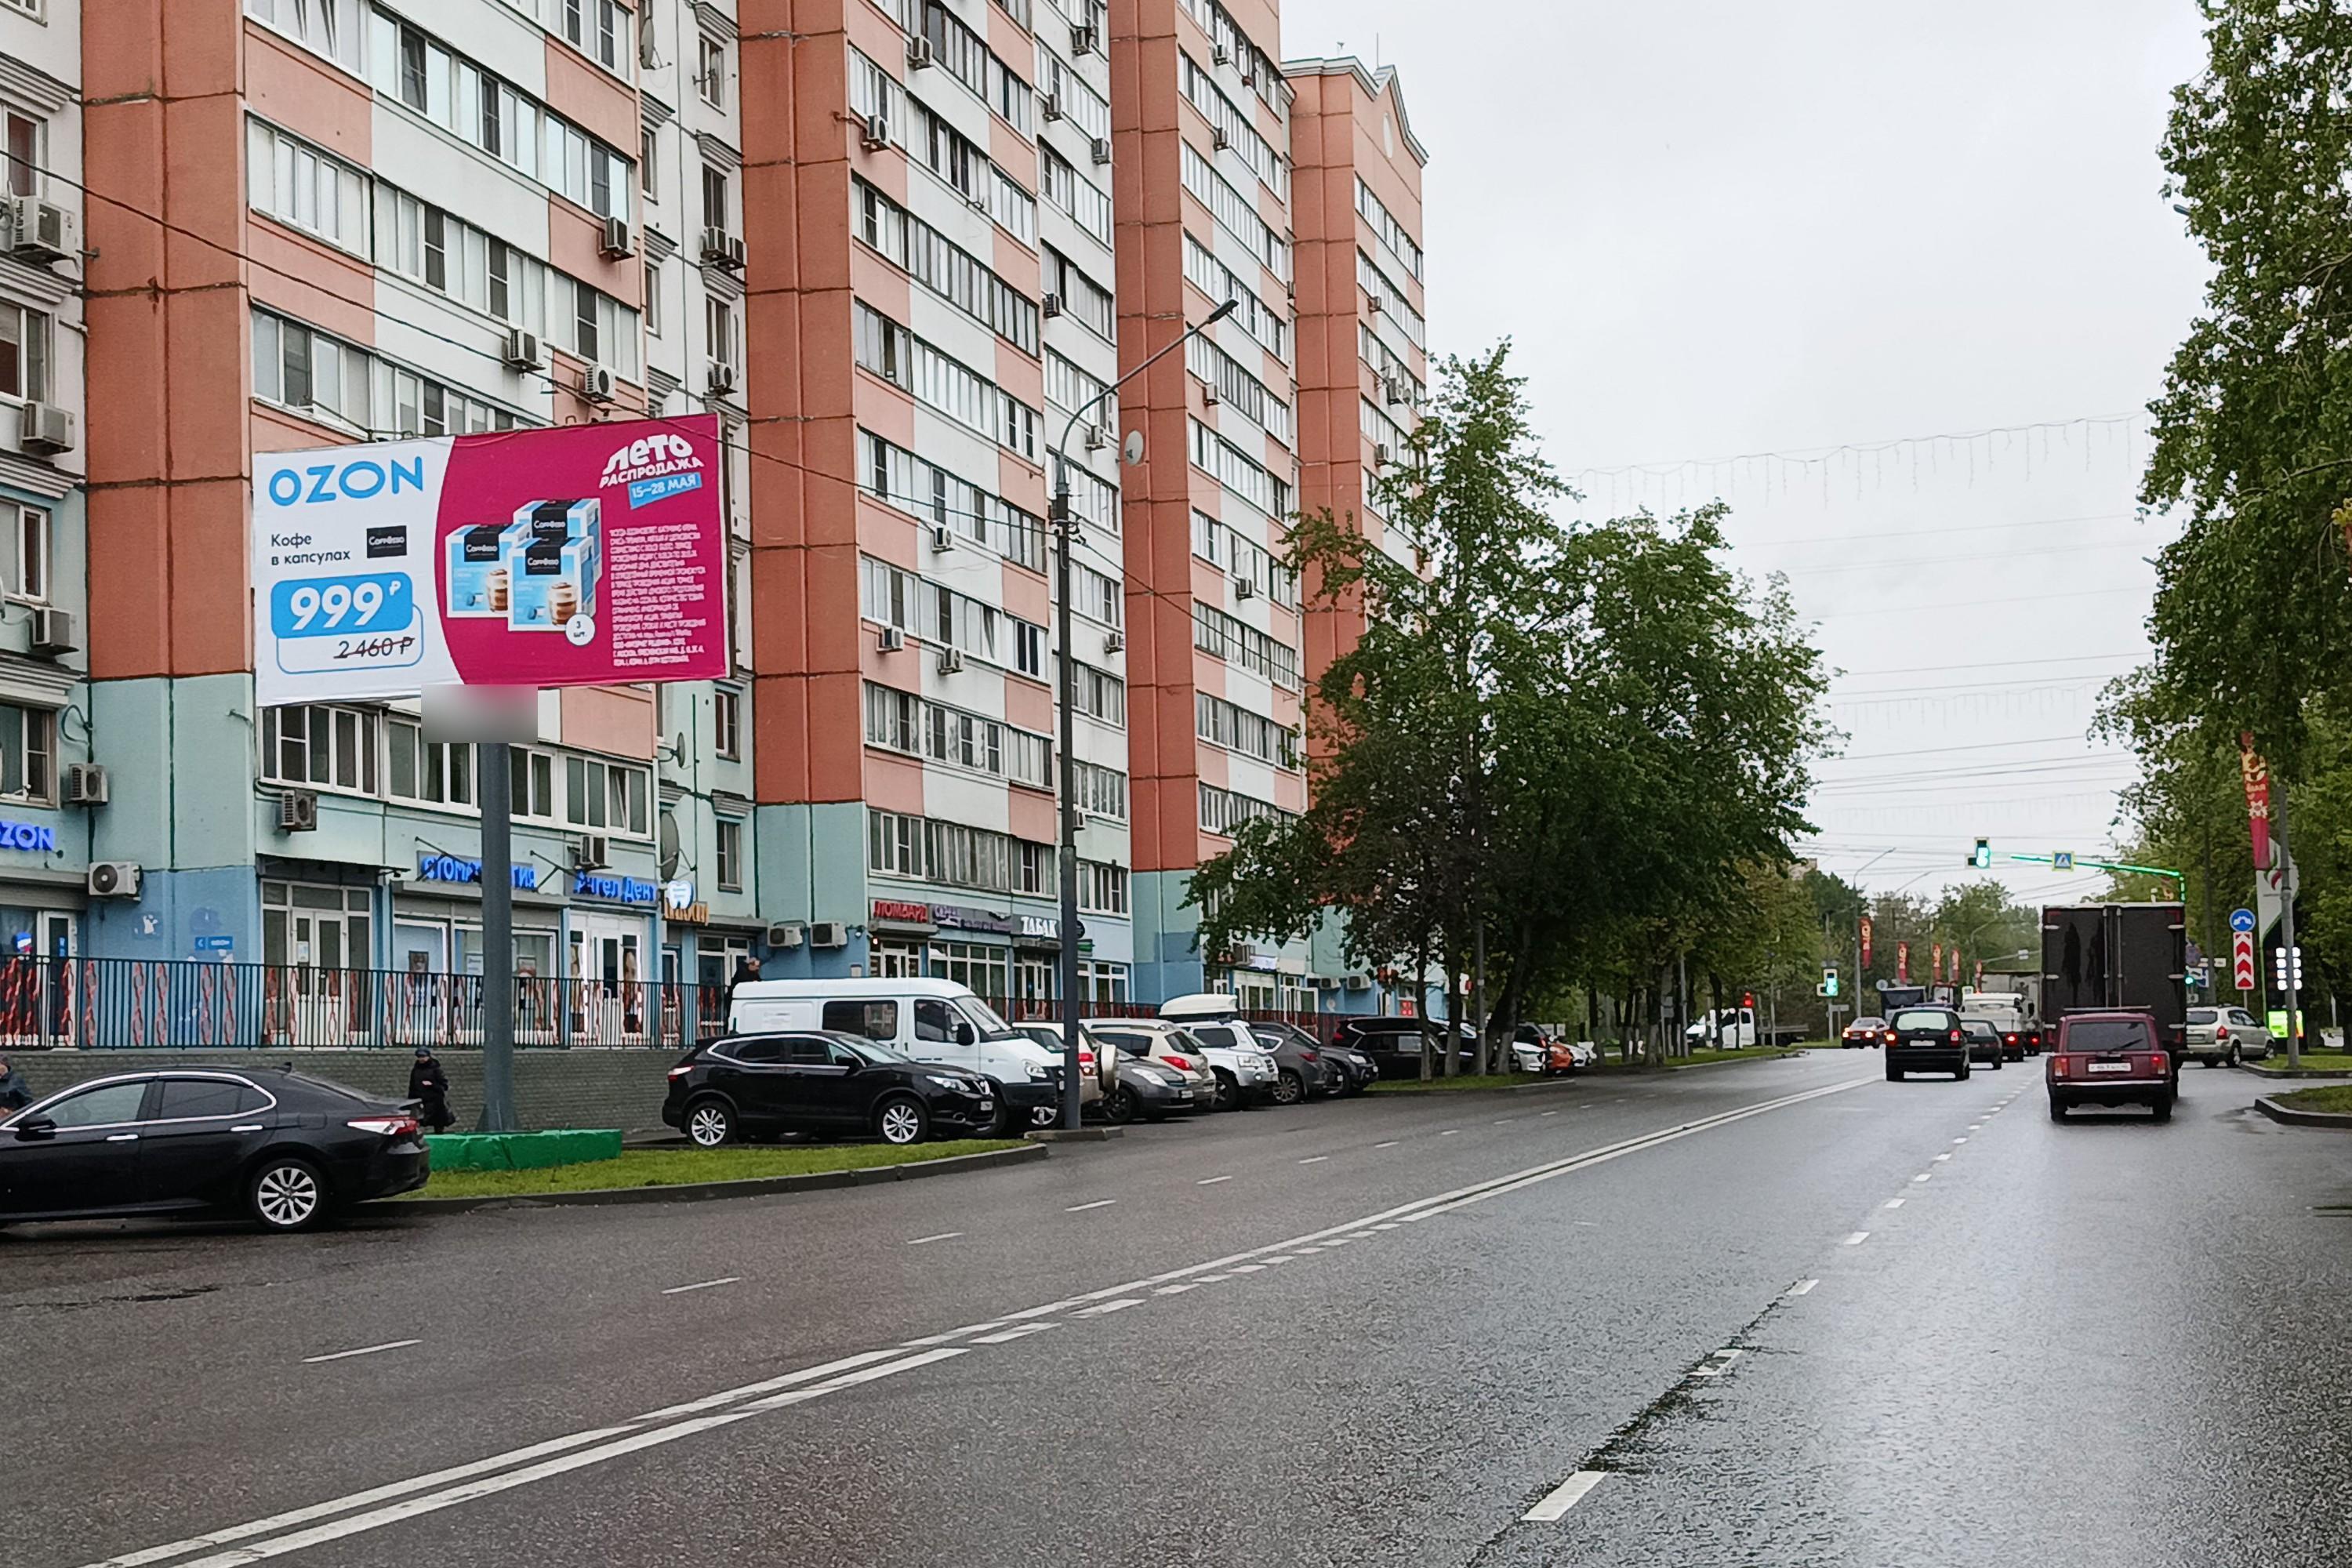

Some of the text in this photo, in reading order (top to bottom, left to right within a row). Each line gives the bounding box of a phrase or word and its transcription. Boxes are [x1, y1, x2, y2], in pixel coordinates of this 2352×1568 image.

[269, 456, 423, 506] OZON
[599, 456, 705, 489] РАСПРОДАЖА
[667, 474, 696, 491] МАЯ
[270, 532, 312, 549] Кофе
[270, 550, 351, 566] в капсулах
[0, 821, 55, 851] ZON
[873, 902, 928, 924] ЛОМБАРД
[1020, 916, 1058, 938] ТАБАК
